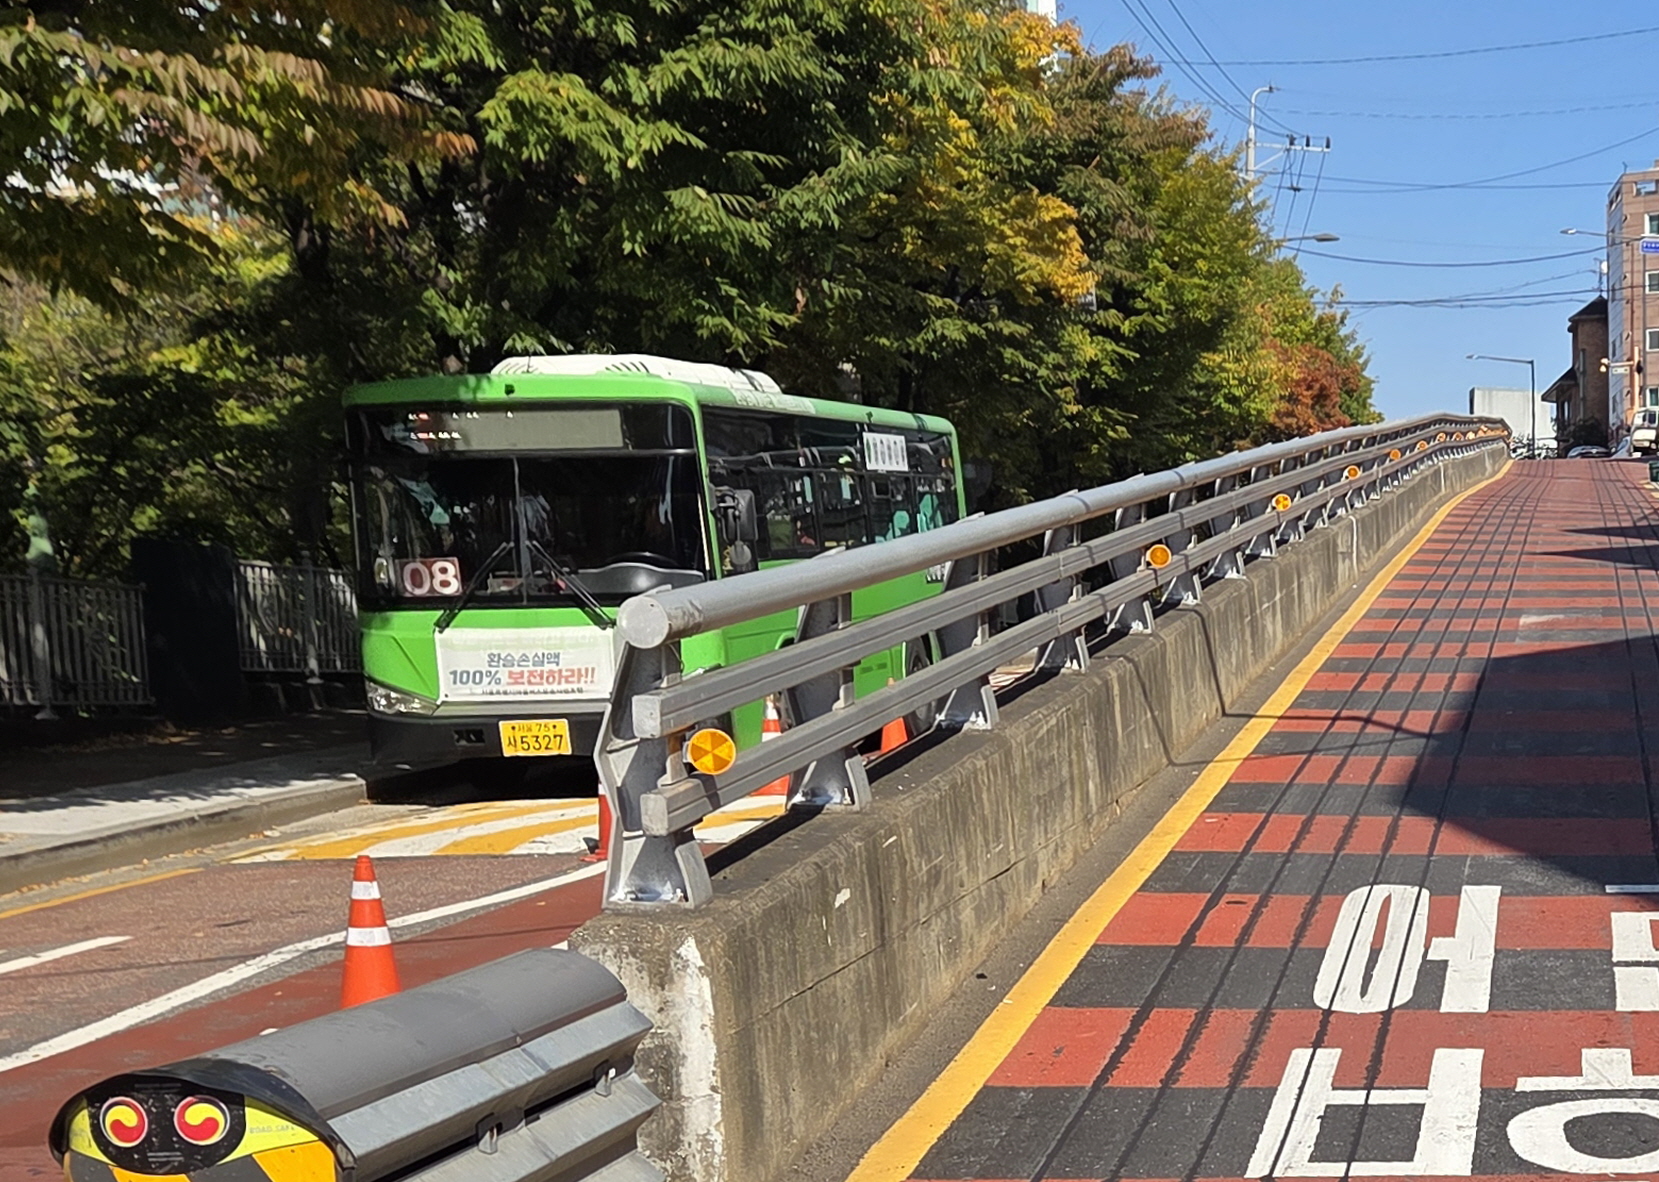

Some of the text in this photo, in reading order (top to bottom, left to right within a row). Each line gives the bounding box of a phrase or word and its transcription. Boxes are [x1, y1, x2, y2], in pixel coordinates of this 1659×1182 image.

[403, 561, 459, 595] 08
[487, 652, 561, 668] 환승손실액
[449, 667, 596, 686] 100% 보전하라!!
[517, 724, 550, 732] 서울 75
